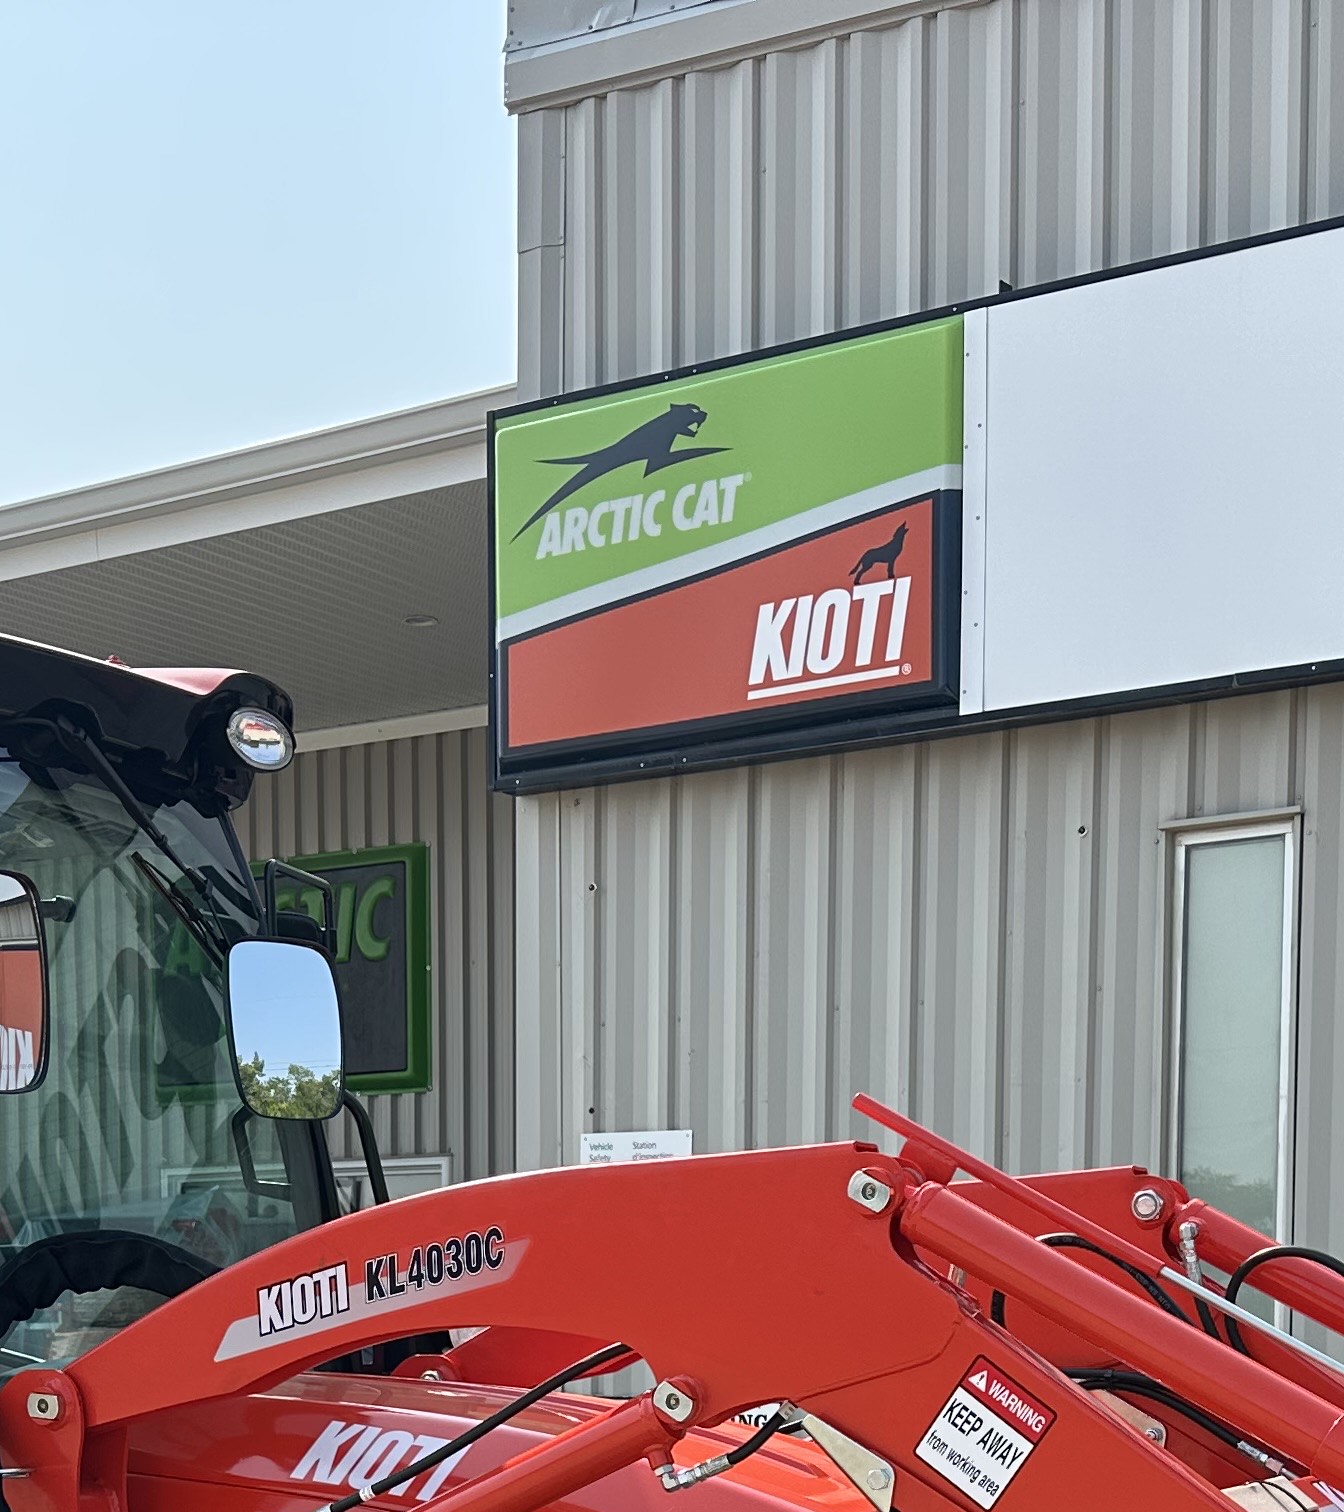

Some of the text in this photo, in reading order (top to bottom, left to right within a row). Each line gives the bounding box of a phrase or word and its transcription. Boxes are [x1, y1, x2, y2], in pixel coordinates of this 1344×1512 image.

[535, 473, 744, 561] ARCTIC CAT
[748, 576, 912, 686] KIOTI
[589, 1143, 613, 1151] Vehicle
[589, 1154, 612, 1163] Safety
[632, 1142, 657, 1150] Station
[257, 1225, 506, 1337] KIOTI KL4030C
[943, 1398, 1025, 1470] KEEP AWAY
[988, 1379, 1046, 1433] WARNING
[289, 1420, 472, 1502] KIOTI
[926, 1429, 1000, 1497] from working area
